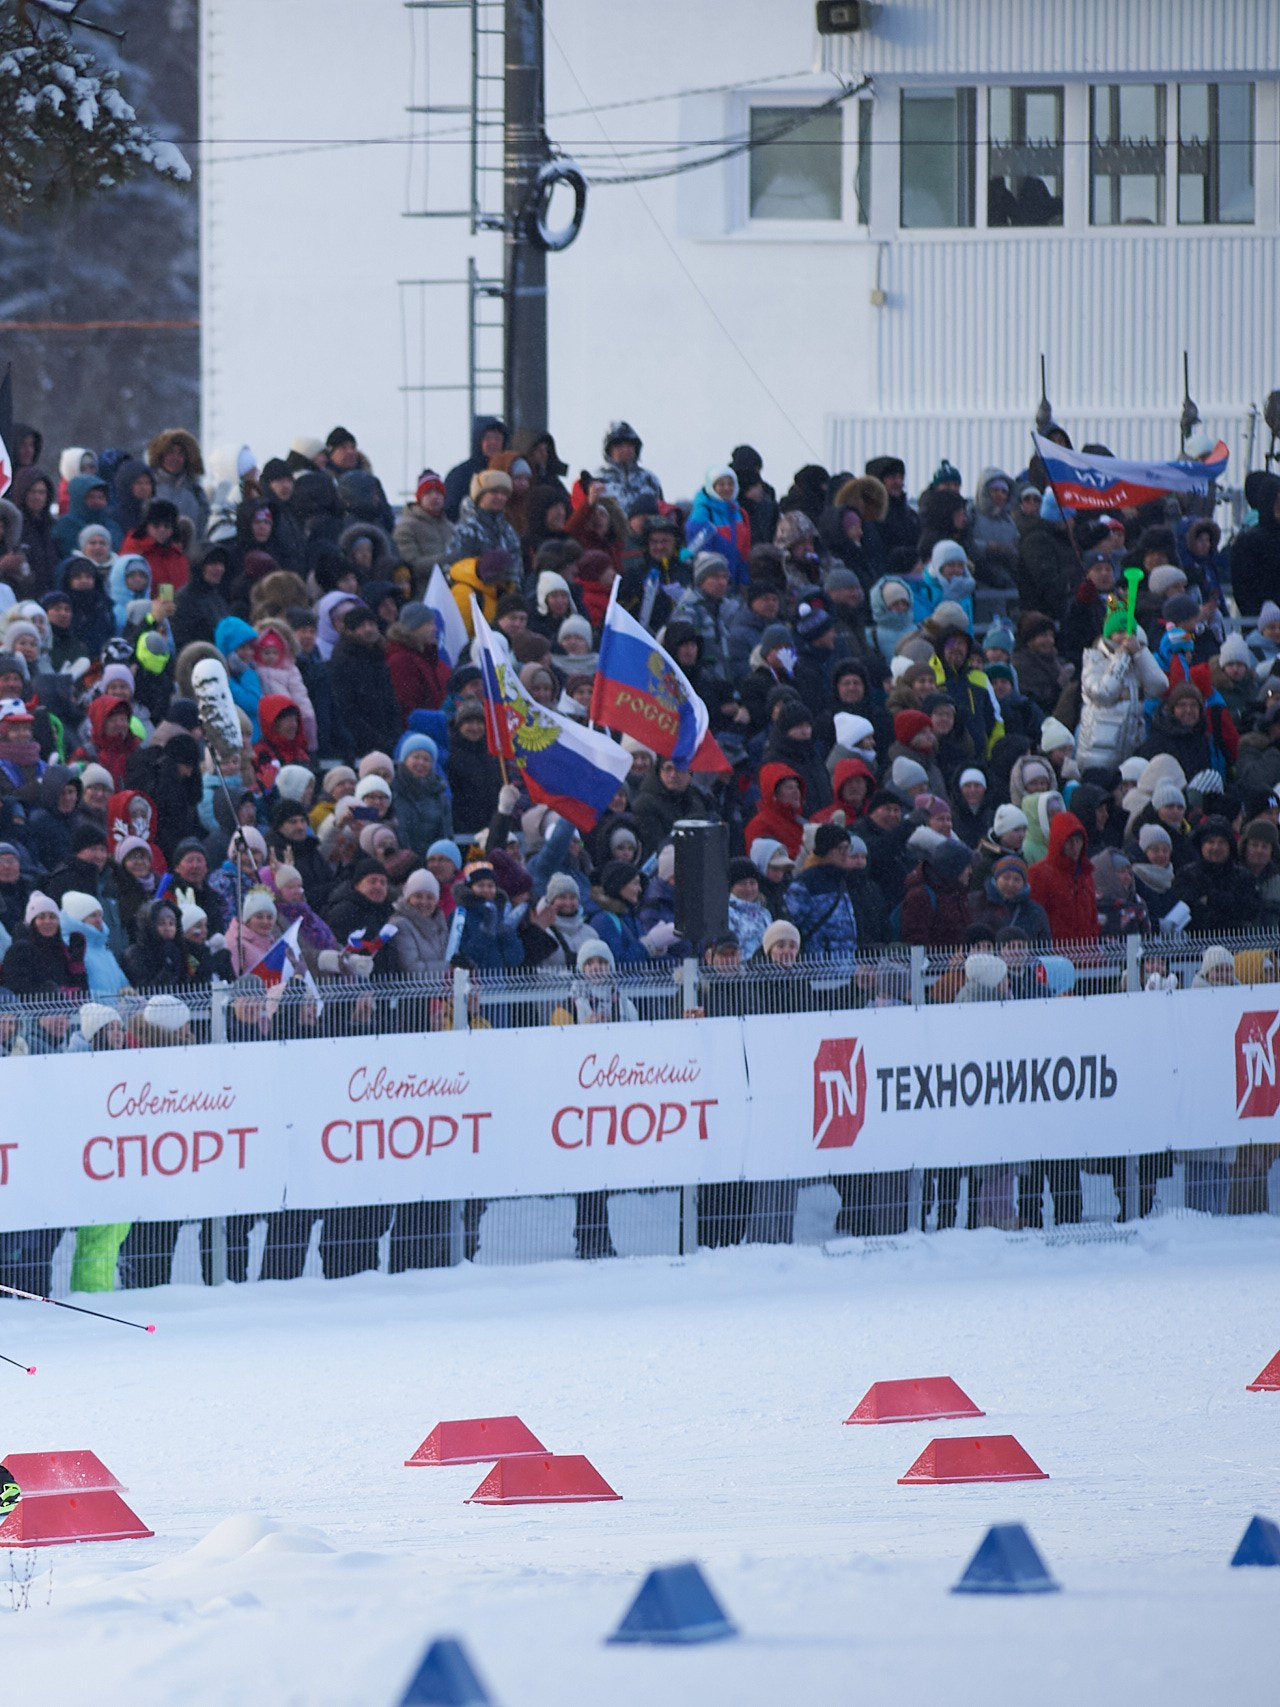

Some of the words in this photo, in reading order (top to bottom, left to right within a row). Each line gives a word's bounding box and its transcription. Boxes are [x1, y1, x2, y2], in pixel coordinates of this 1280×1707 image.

[348, 1066, 469, 1103] Советский
[578, 1053, 701, 1090] Советский
[876, 1054, 1118, 1113] ТЕХНОНИКОЛЬ
[107, 1081, 236, 1118] Советский
[321, 1113, 492, 1164] СПОРТ
[551, 1100, 719, 1149] СПОРТ
[82, 1127, 259, 1182] СПОРТ
